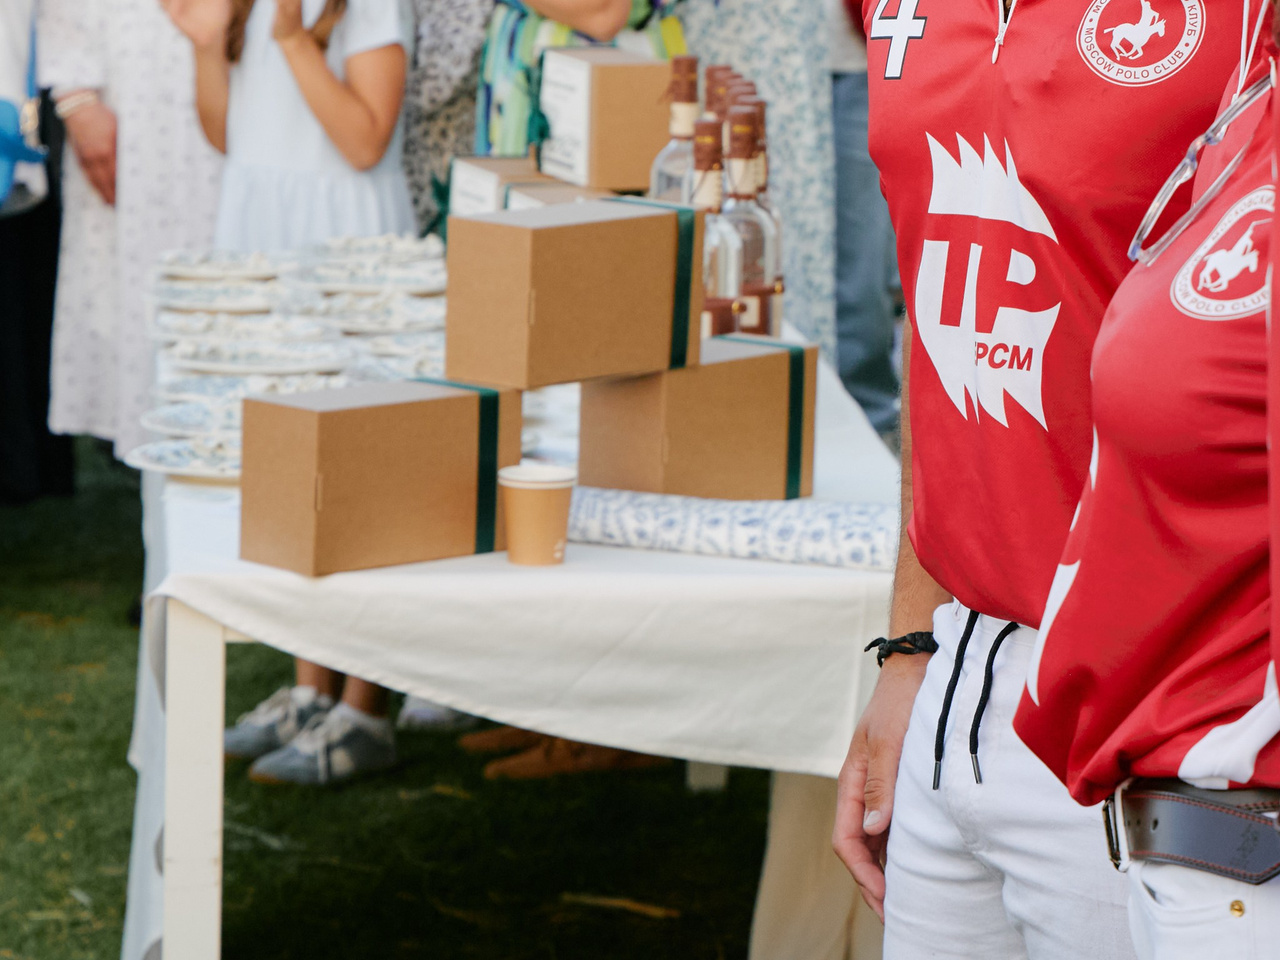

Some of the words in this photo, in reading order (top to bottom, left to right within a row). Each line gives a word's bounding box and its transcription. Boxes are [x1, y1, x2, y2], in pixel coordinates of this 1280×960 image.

[1187, 4, 1198, 37] КЛУБ
[1084, 27, 1115, 73] MOSCOW
[1115, 69, 1150, 80] POLO
[1153, 50, 1184, 74] CLUB
[974, 341, 1034, 372] PCM
